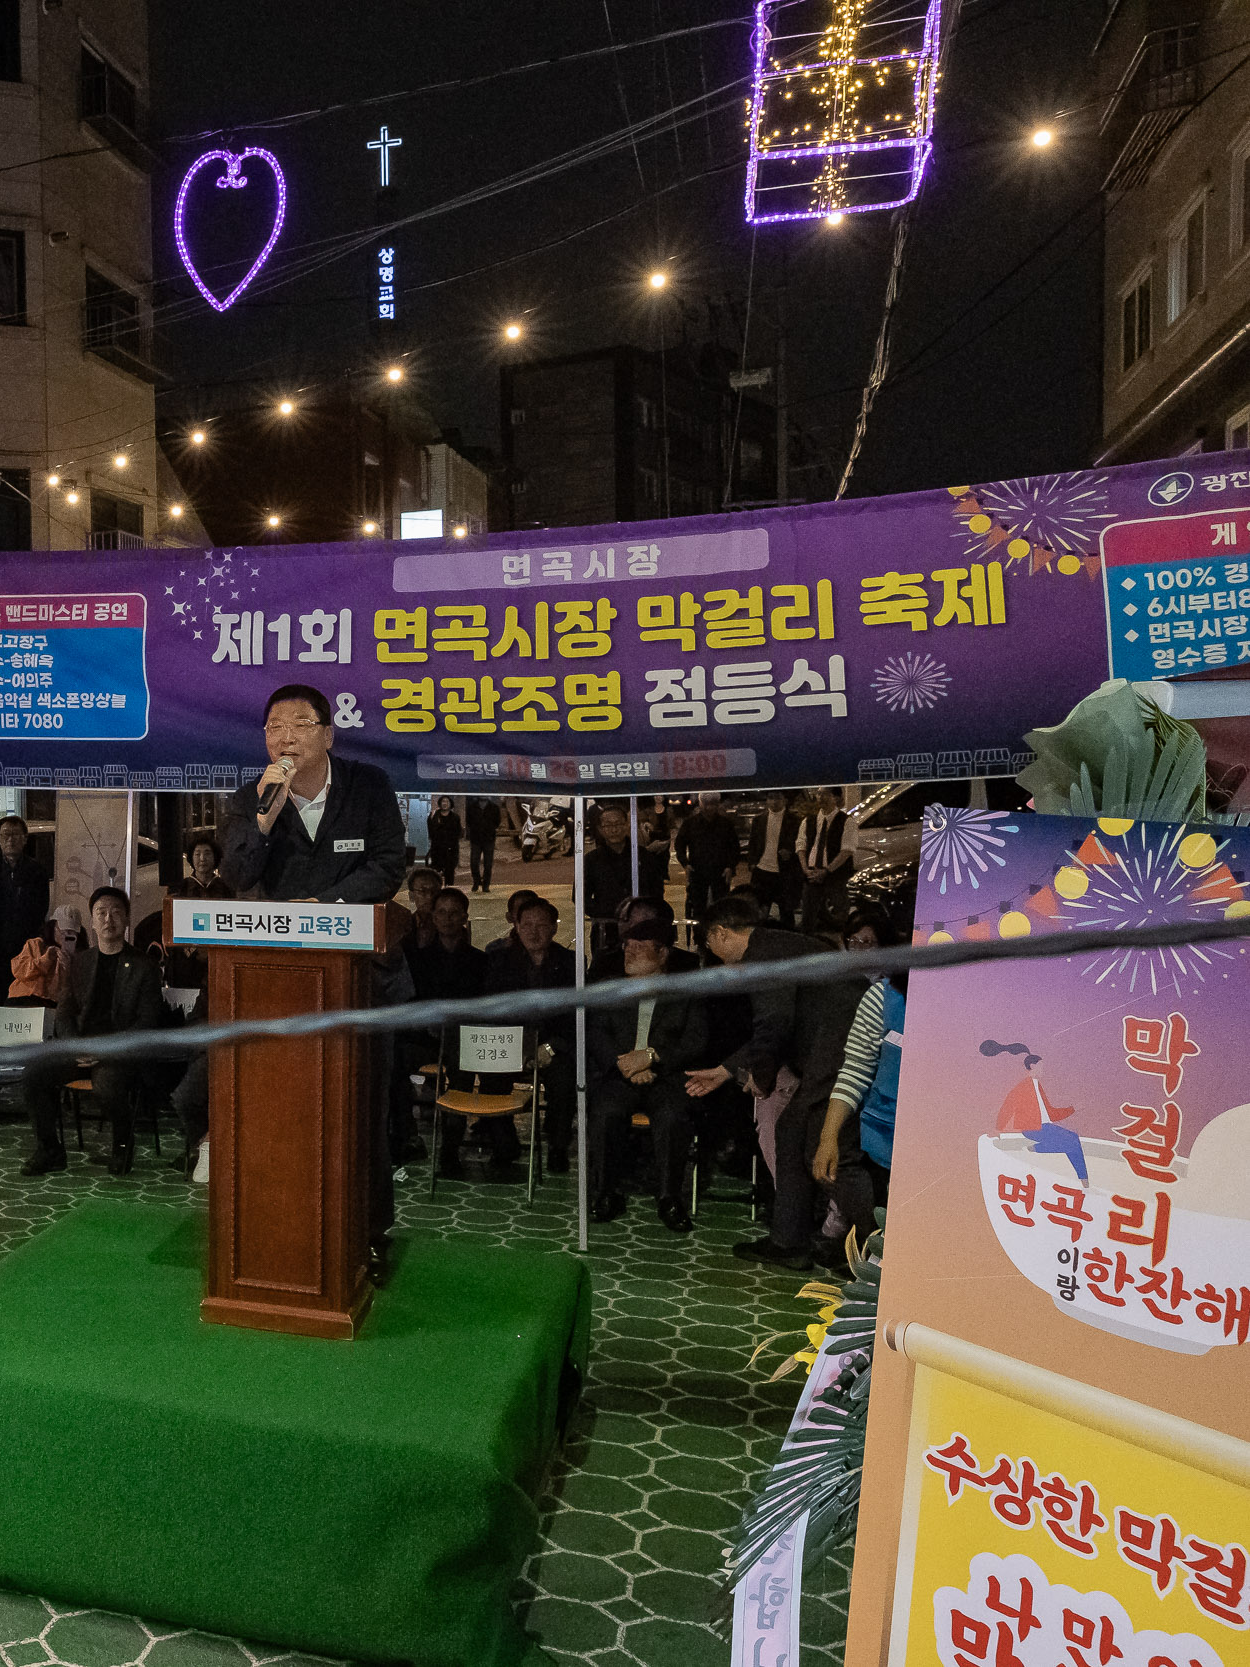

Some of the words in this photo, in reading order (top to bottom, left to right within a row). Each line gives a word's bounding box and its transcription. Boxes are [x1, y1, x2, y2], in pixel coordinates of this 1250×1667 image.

[1144, 566, 1216, 591] 100%
[6, 603, 88, 622] 밴드마스터
[94, 602, 128, 621] 공연
[212, 607, 352, 665] 제1회
[374, 597, 618, 663] 면곡시장
[637, 578, 835, 651] 막걸리
[859, 561, 1006, 631] 축제
[1149, 614, 1249, 643] 면곡시장
[1152, 642, 1227, 669] 영수증
[37, 693, 126, 709] 색소폰앙상블
[334, 692, 364, 728] &
[381, 669, 623, 733] 경관조명
[645, 654, 848, 728] 점등식
[23, 713, 64, 729] 7080
[446, 762, 499, 776] 2023년
[600, 761, 651, 778] 목요일
[215, 913, 291, 934] 면곡시장
[298, 915, 352, 936] 교육장
[470, 1033, 514, 1044] 광진구청장
[476, 1049, 509, 1060] 김경호
[1107, 1012, 1199, 1264] 막걸리
[997, 1173, 1093, 1243] 면곡
[1056, 1246, 1080, 1302] 이랑
[926, 1435, 1105, 1555] 수상한
[1119, 1509, 1250, 1625] 막걸
